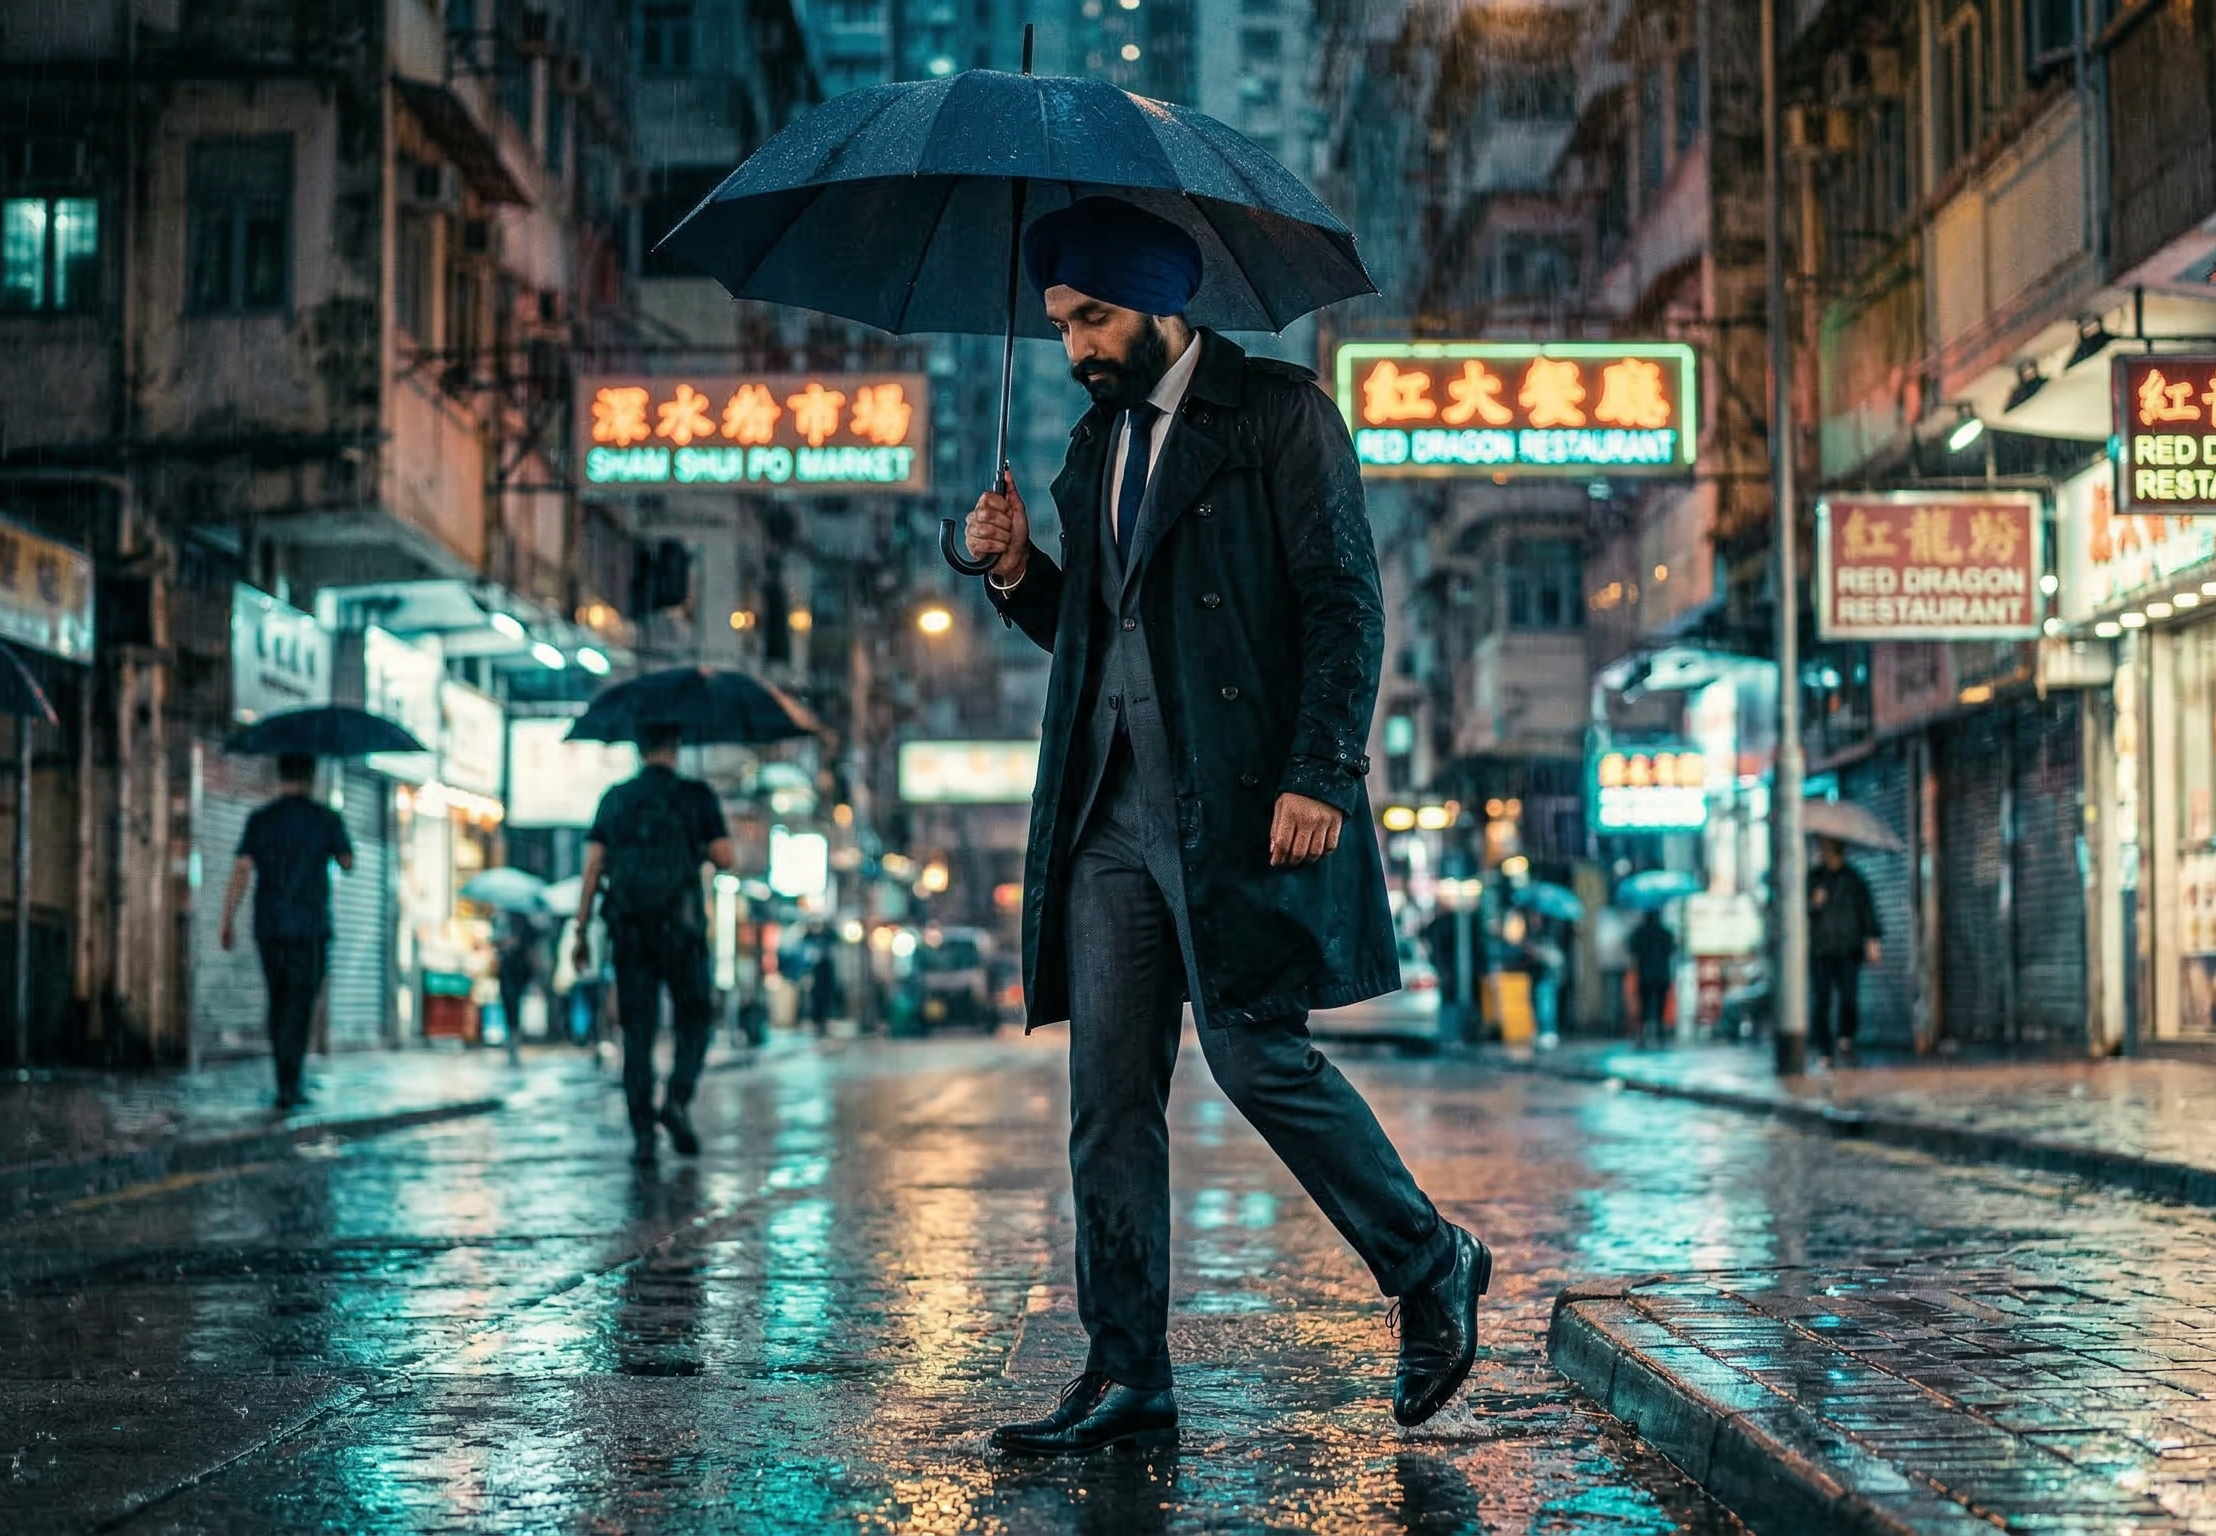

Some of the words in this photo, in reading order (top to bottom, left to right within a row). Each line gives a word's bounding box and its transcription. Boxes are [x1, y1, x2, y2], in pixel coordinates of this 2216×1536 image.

[2138, 368, 2216, 428] 紅
[1356, 429, 1409, 464] RED
[1411, 429, 1515, 464] DRAGON
[1518, 429, 1677, 464] RESTAURANT
[2135, 435, 2197, 465] RED
[586, 446, 670, 483] SHAM
[674, 446, 743, 483] SHUI
[747, 446, 793, 483] PO
[796, 446, 915, 483] MARKET
[1837, 566, 1898, 595] RED
[1902, 566, 2025, 595] DRAGON
[1837, 596, 2025, 625] RESTAURANT
